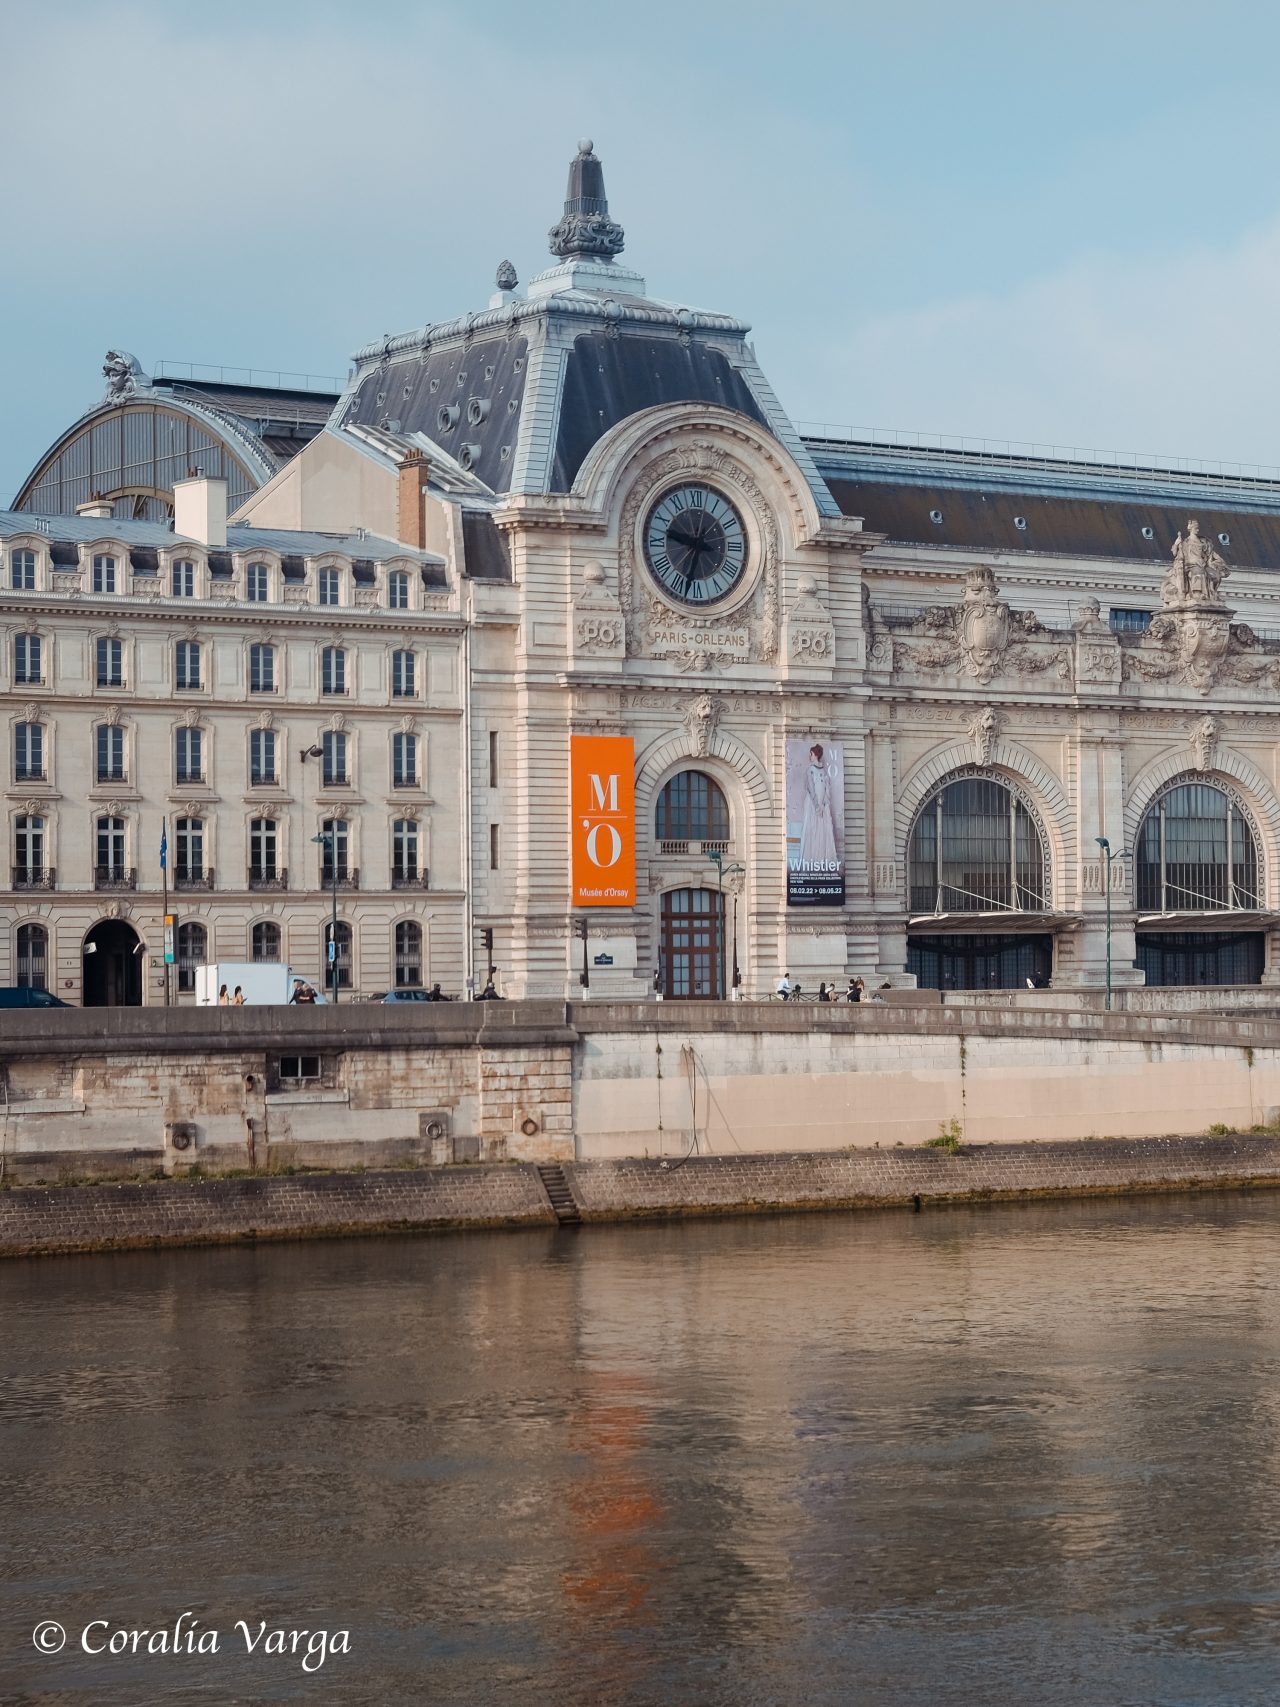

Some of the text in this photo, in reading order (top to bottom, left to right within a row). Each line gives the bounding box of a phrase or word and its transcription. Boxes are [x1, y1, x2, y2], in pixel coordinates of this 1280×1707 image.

[584, 623, 615, 643] PO
[654, 631, 746, 647] PARIS-ORLEANS
[798, 635, 826, 653] PO
[588, 774, 621, 811] M
[789, 858, 842, 871] Whistler
[579, 888, 603, 897] Musée
